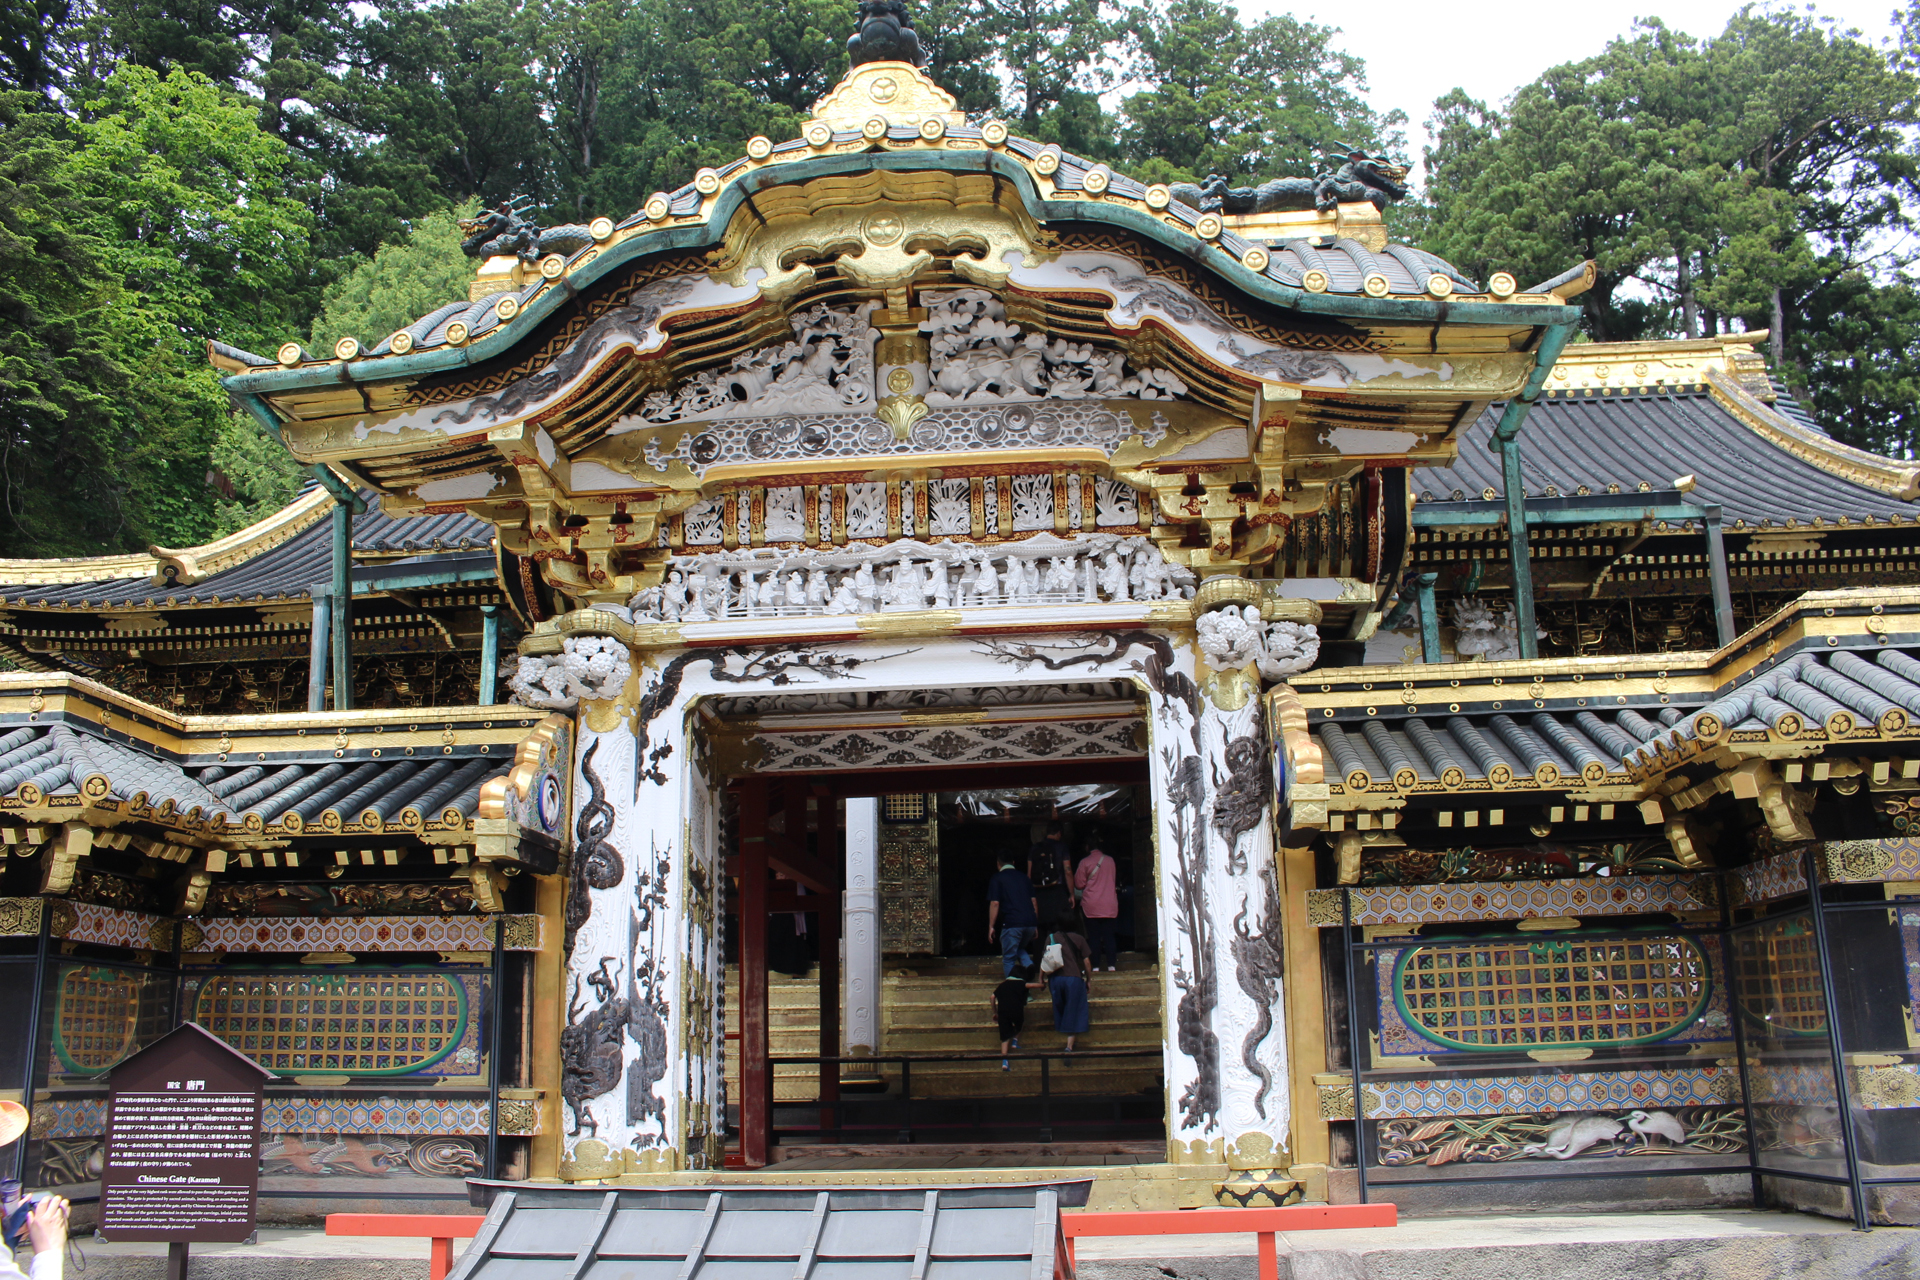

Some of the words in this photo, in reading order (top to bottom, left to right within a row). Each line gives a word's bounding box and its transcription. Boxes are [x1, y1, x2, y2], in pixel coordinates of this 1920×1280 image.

[167, 1081, 181, 1089] 国宝
[186, 1080, 206, 1090] 唐門
[138, 1175, 167, 1183] Chinese
[169, 1175, 186, 1183] Gate
[188, 1176, 220, 1184] (Karamon)
